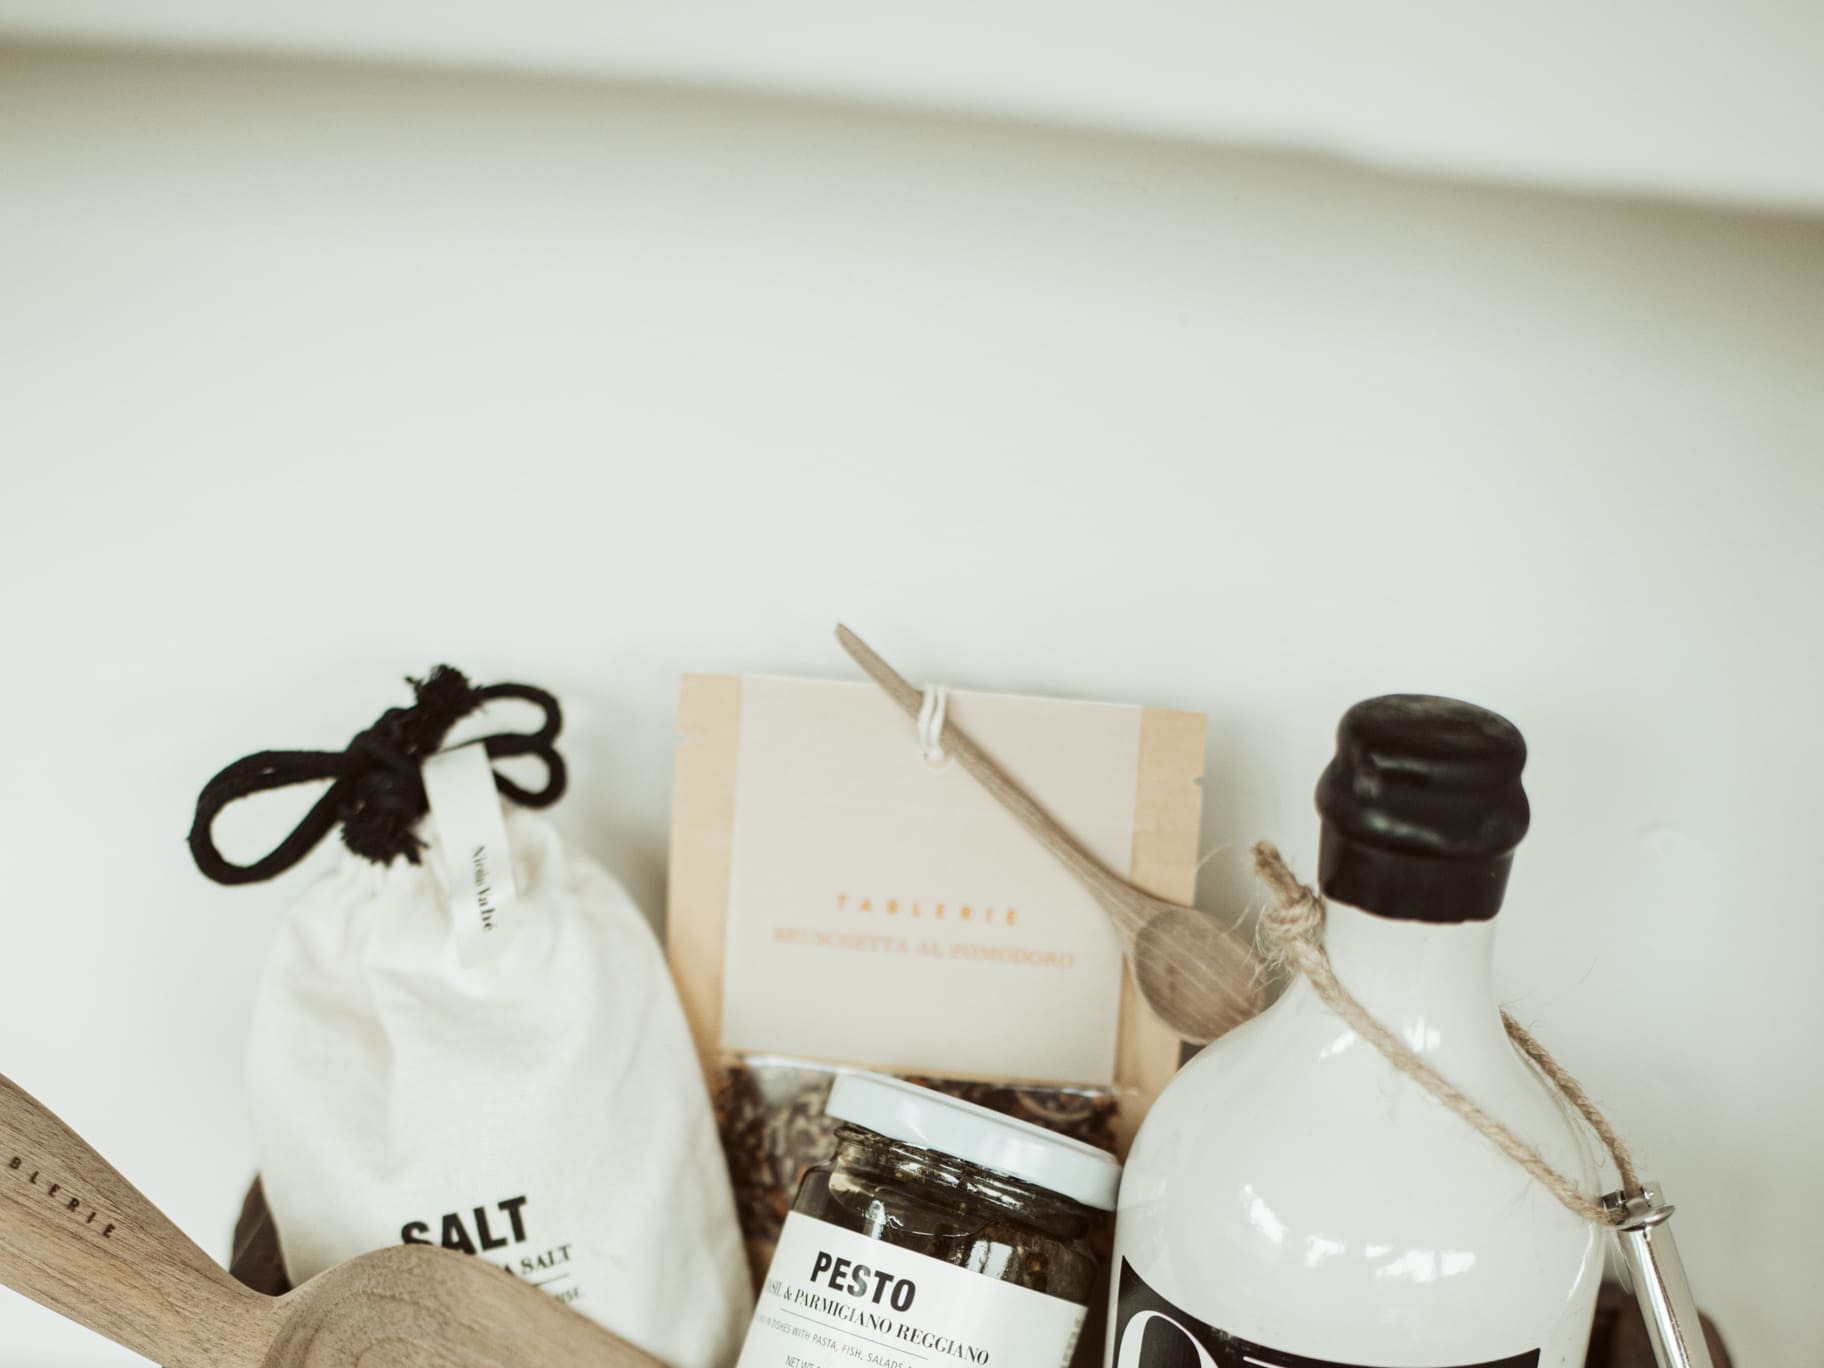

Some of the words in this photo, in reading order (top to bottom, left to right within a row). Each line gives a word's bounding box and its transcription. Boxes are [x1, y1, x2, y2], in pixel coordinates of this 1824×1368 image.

[836, 893, 1017, 926] TABLERIE
[916, 940, 944, 959] AL
[401, 1195, 527, 1256] SALT
[520, 1242, 572, 1275] SALT
[809, 1250, 917, 1313] PESTO
[783, 1284, 794, 1301] &
[794, 1288, 893, 1335] PARMIGIANO
[896, 1322, 990, 1366] REGGIANO
[791, 1326, 811, 1340] WITH
[812, 1333, 838, 1353] PASTA,
[841, 1343, 863, 1361] FISH,
[784, 1354, 801, 1368] NET
